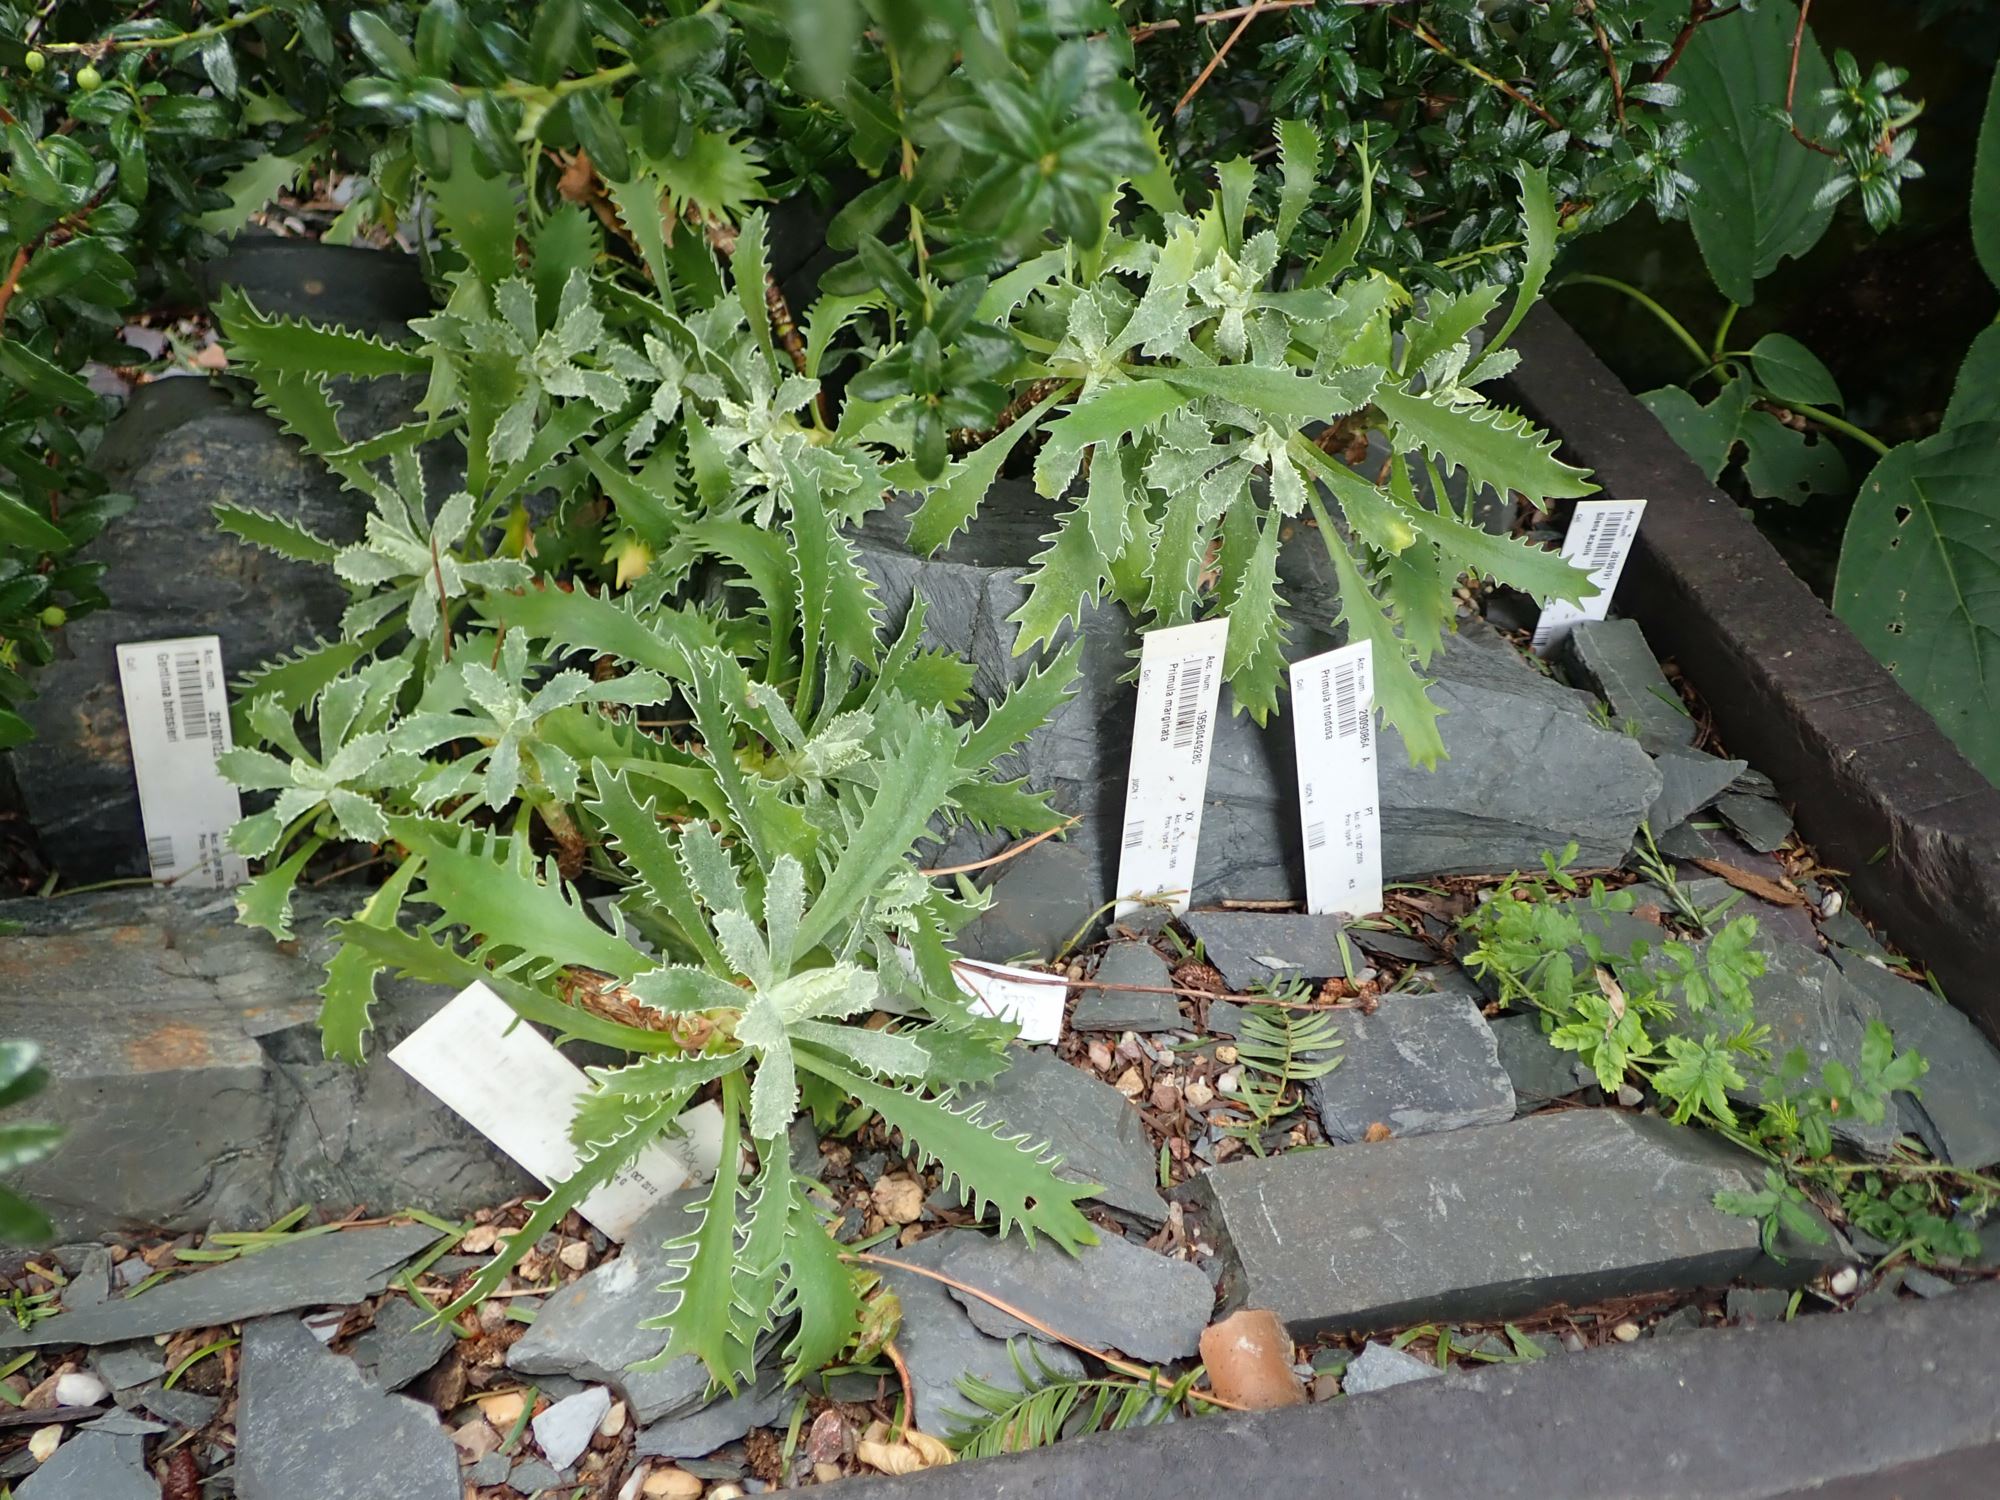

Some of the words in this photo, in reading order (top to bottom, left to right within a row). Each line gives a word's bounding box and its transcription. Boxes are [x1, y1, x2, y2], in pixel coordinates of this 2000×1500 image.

[1591, 512, 1605, 532] Silene
[1583, 534, 1596, 556] acaulis
[1166, 663, 1178, 697] Primula
[1321, 669, 1331, 702] Primula
[1160, 700, 1173, 742] marginata
[1192, 710, 1208, 765] 1958044928C
[1323, 704, 1333, 740] frondosa
[1359, 709, 1369, 748] 20090864
[1363, 807, 1373, 816] PT
[631, 1171, 644, 1184] OCT
[641, 1180, 658, 1196] 2012
